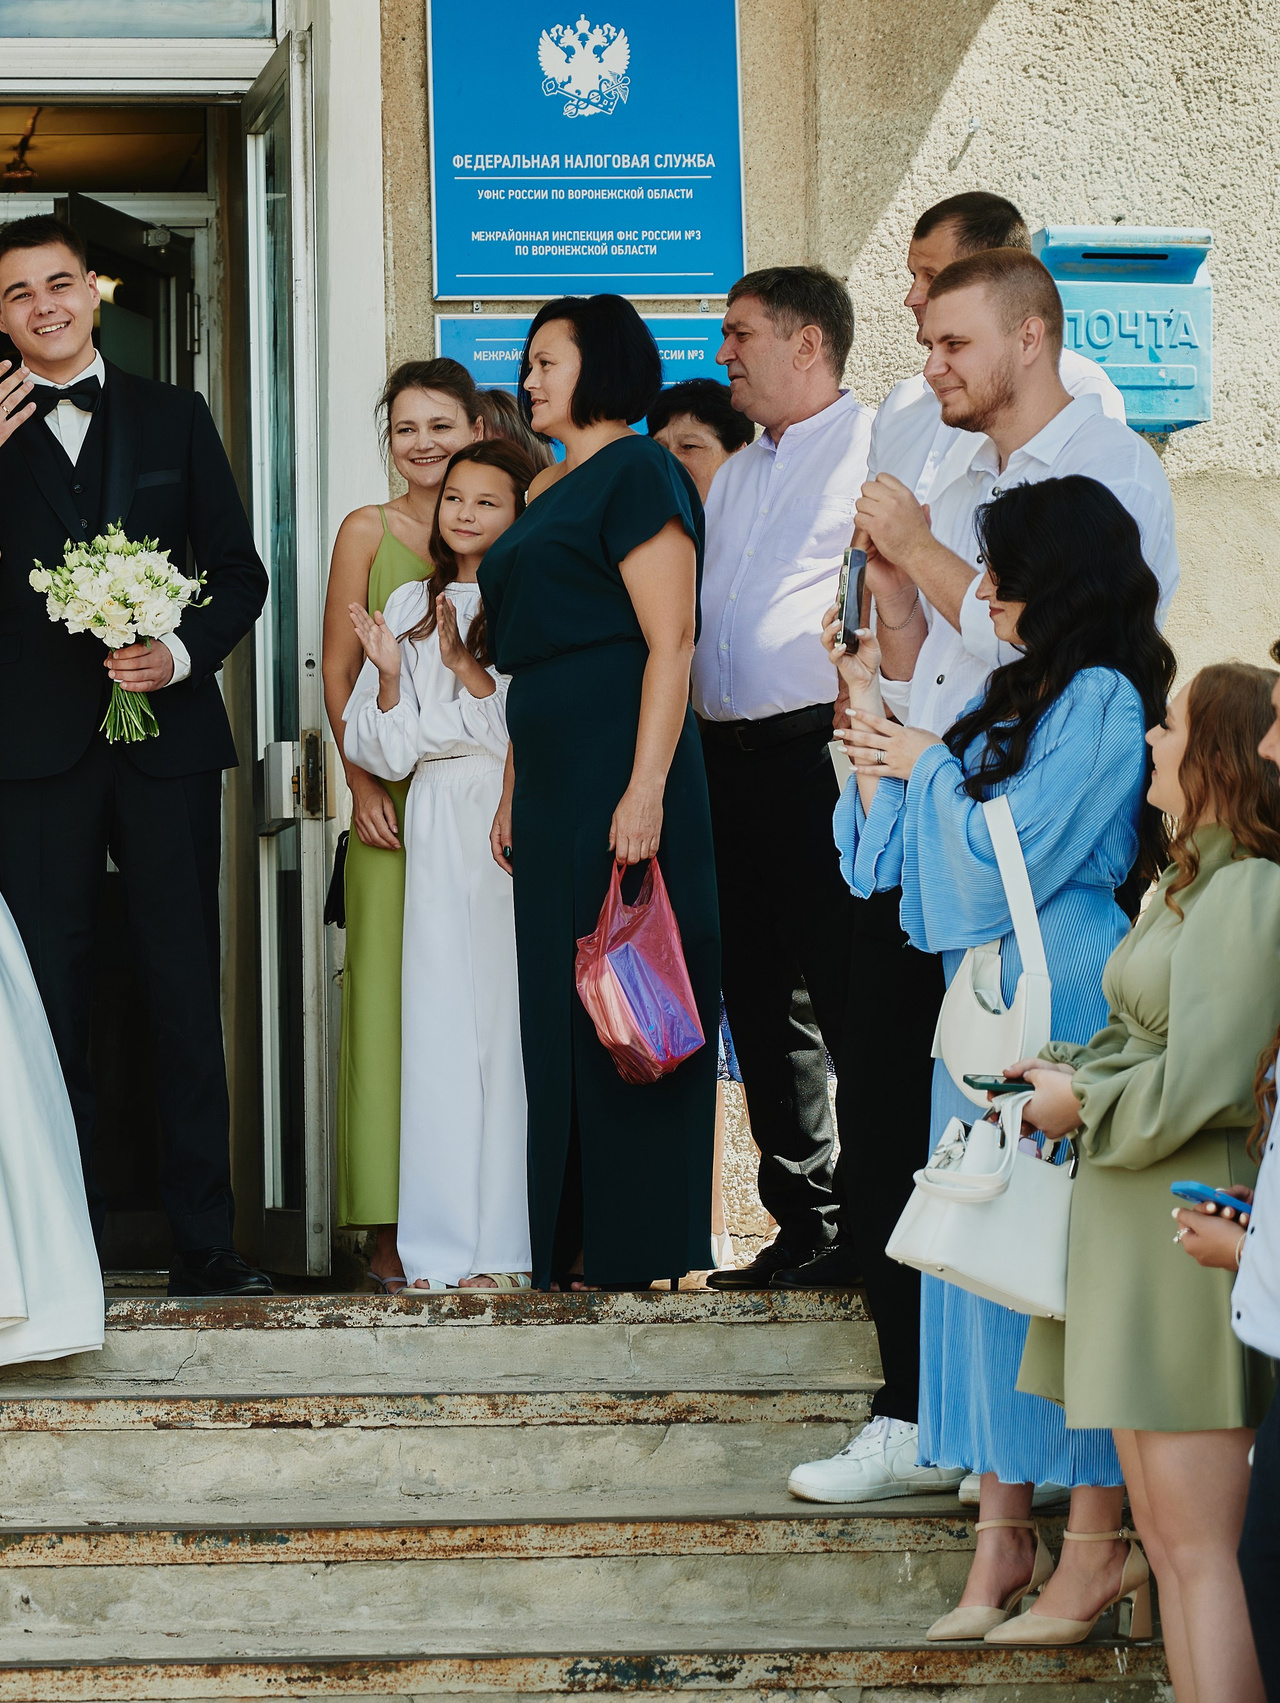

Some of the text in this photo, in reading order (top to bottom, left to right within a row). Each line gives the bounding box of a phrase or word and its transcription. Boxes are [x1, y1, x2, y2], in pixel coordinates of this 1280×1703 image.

[452, 153, 716, 171] ФЕДЕРАЛЬНАЯ НАЛОГОВАЯ СЛУЖБА
[477, 187, 693, 201] УФНС РОССИИ ПО ВОРОНЕЖСКОЙ ОБЛАСТИ
[471, 228, 702, 243] МЕЖРАЙОННАЯ ИНСПЕКЦИЯ ФНС РОССИИ №3
[515, 243, 657, 256] ПО ВОРОНЕЖСКОЙ ОБЛАСТИ
[1063, 309, 1200, 350] ПОЧТА
[687, 349, 705, 360] №3
